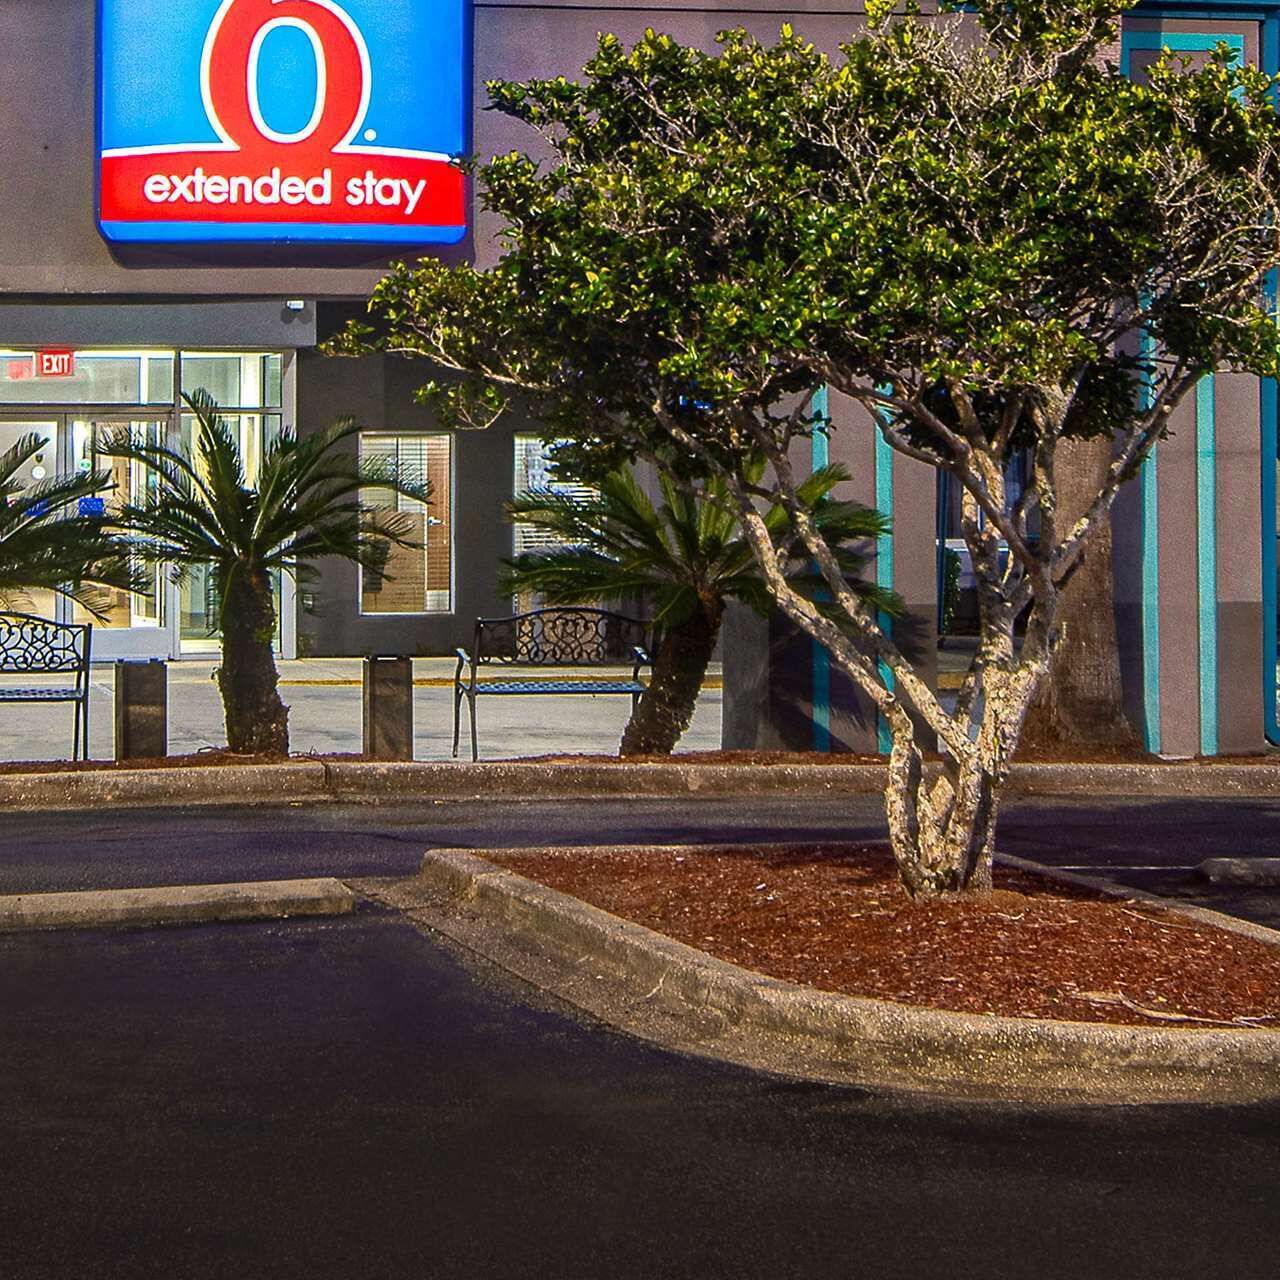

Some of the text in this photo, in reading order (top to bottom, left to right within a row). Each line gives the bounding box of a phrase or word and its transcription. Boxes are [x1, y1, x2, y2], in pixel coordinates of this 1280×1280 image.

[143, 166, 427, 215] extended stay
[42, 354, 71, 374] EXIT
